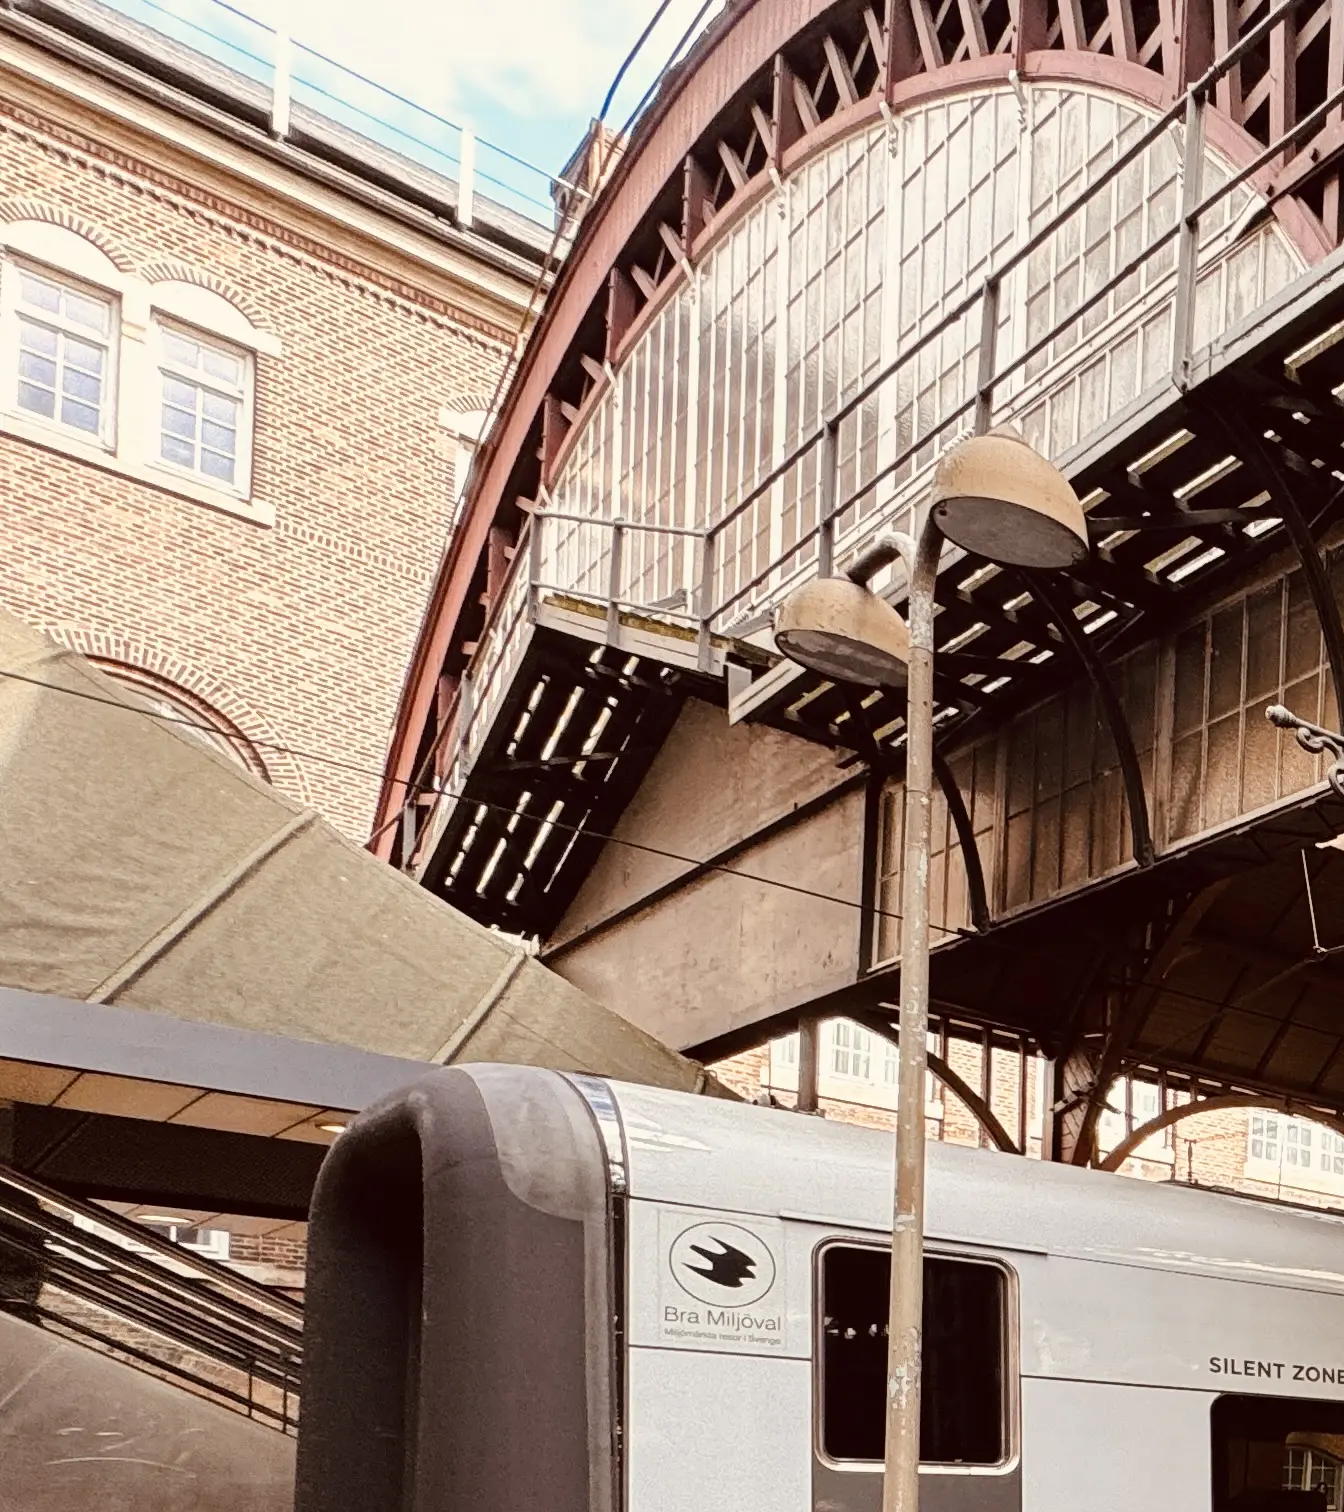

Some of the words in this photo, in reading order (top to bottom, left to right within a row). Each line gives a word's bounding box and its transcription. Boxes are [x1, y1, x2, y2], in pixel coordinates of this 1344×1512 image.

[664, 1306, 700, 1324] Bra
[706, 1310, 781, 1331] Miljöval
[1209, 1356, 1286, 1379] SILENT
